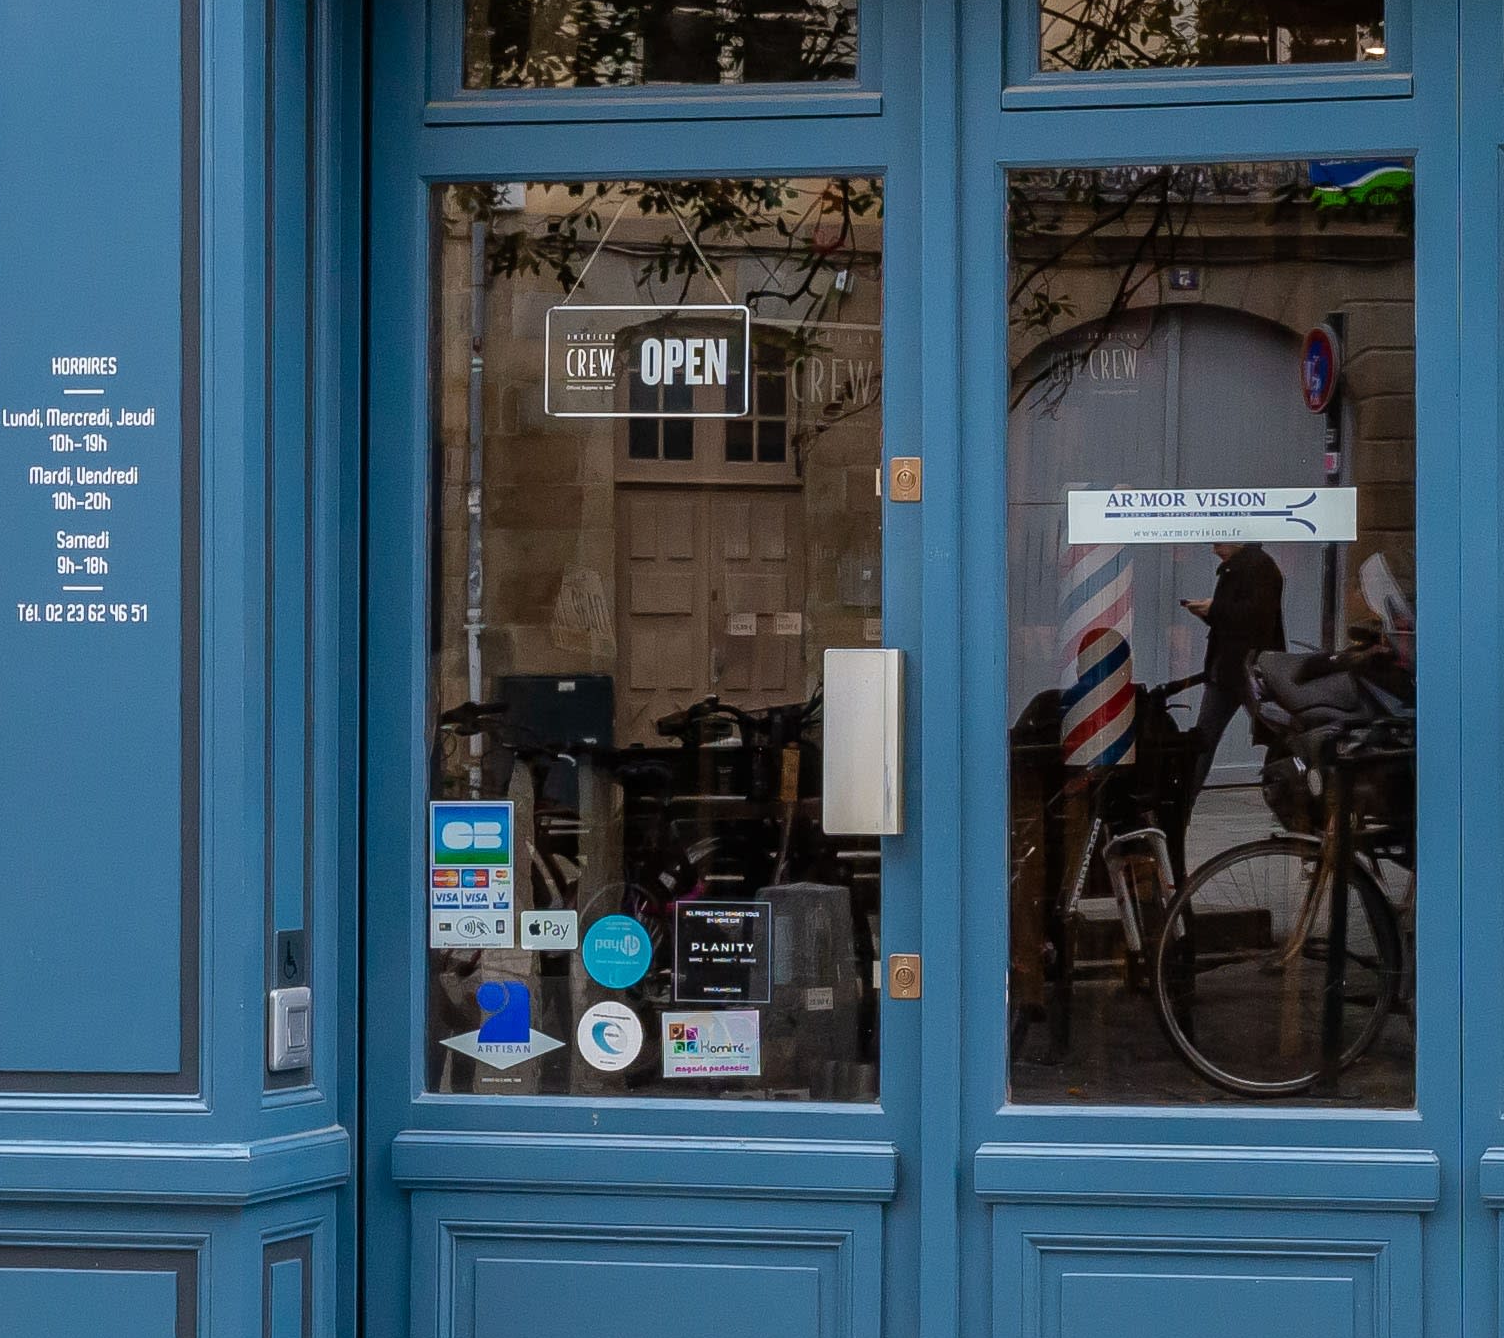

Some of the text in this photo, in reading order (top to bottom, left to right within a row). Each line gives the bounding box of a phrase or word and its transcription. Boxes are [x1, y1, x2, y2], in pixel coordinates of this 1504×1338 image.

[52, 357, 117, 375] HORAIRES
[641, 337, 728, 386] OPEN
[1089, 349, 1137, 379] CREW
[3, 408, 155, 428] Lundi, Mercredi, Jeudi
[29, 467, 138, 486] Mardi, Vendredi
[1106, 492, 1266, 508] AR'MOR VISION
[56, 531, 109, 549] Samedi
[1133, 528, 1242, 538] www.armorvision.fr
[17, 604, 148, 622] Tél. 02 23 62 46 51
[442, 821, 502, 849] CB
[436, 892, 458, 902] VISA
[465, 892, 488, 902] VISA
[544, 920, 569, 940] Pay
[691, 942, 754, 953] PLANITY
[477, 1044, 531, 1054] ARTISAN
